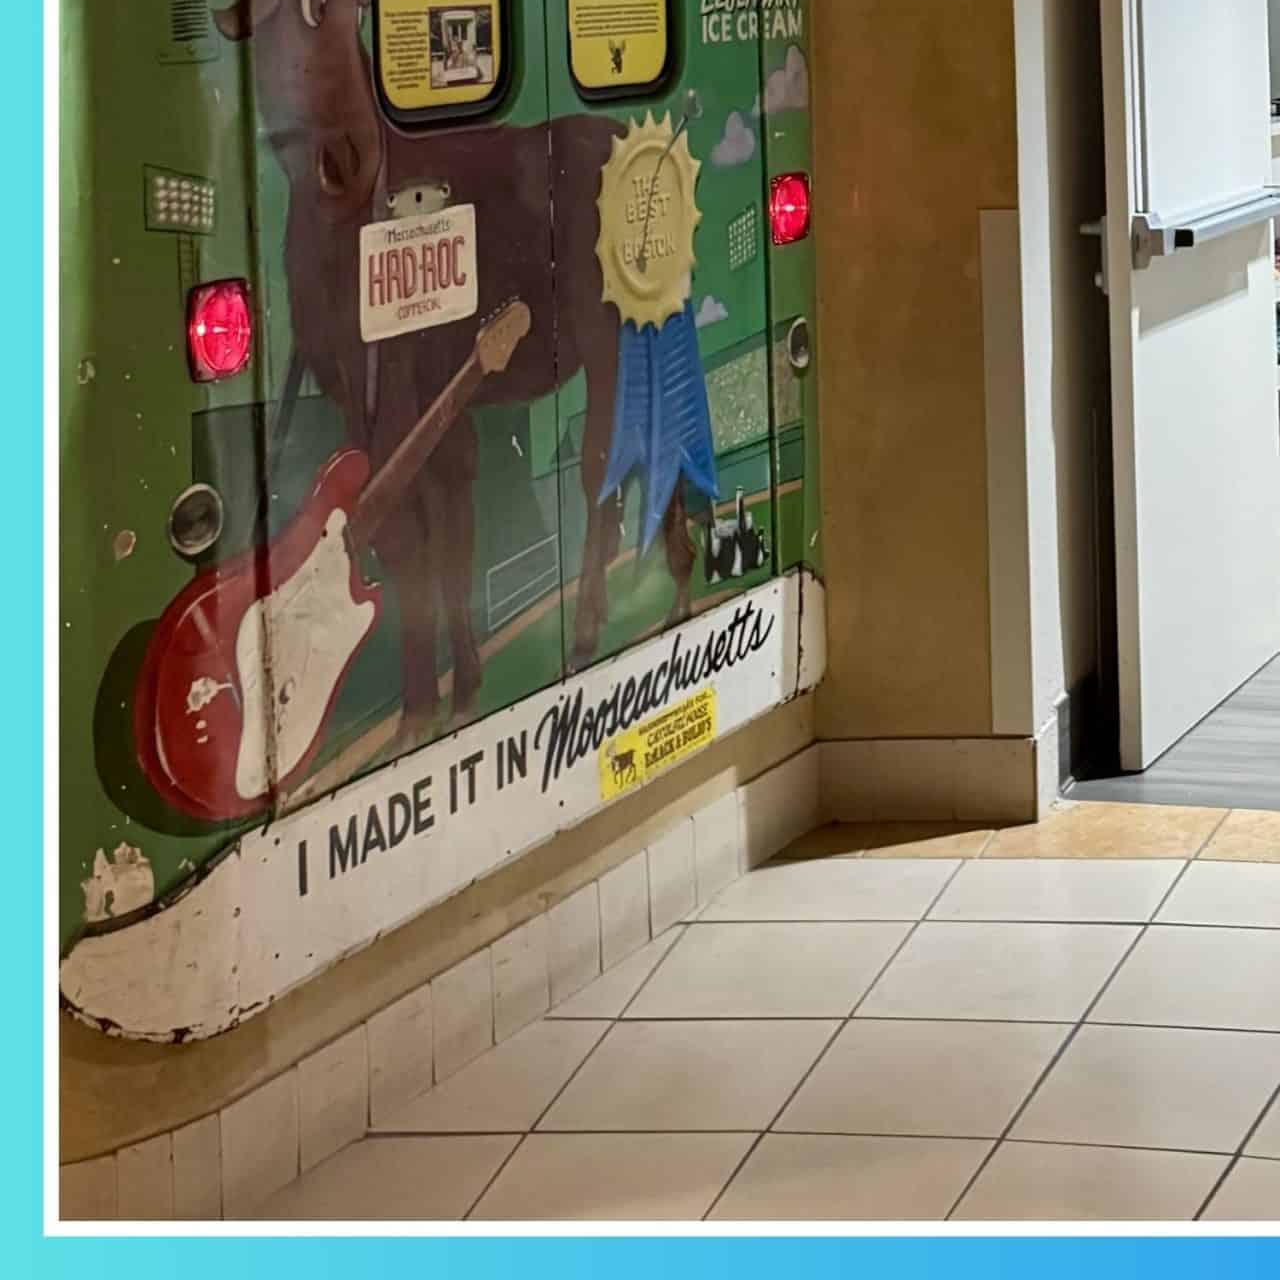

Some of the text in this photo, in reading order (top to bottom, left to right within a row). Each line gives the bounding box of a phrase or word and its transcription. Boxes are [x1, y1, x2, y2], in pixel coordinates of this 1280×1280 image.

[702, 8, 802, 43] ICE CREAM
[298, 841, 307, 896] I
[329, 776, 434, 879] MADE
[449, 751, 484, 815] IT
[497, 731, 528, 790] IN
[533, 599, 776, 793] Mooseachusetts
